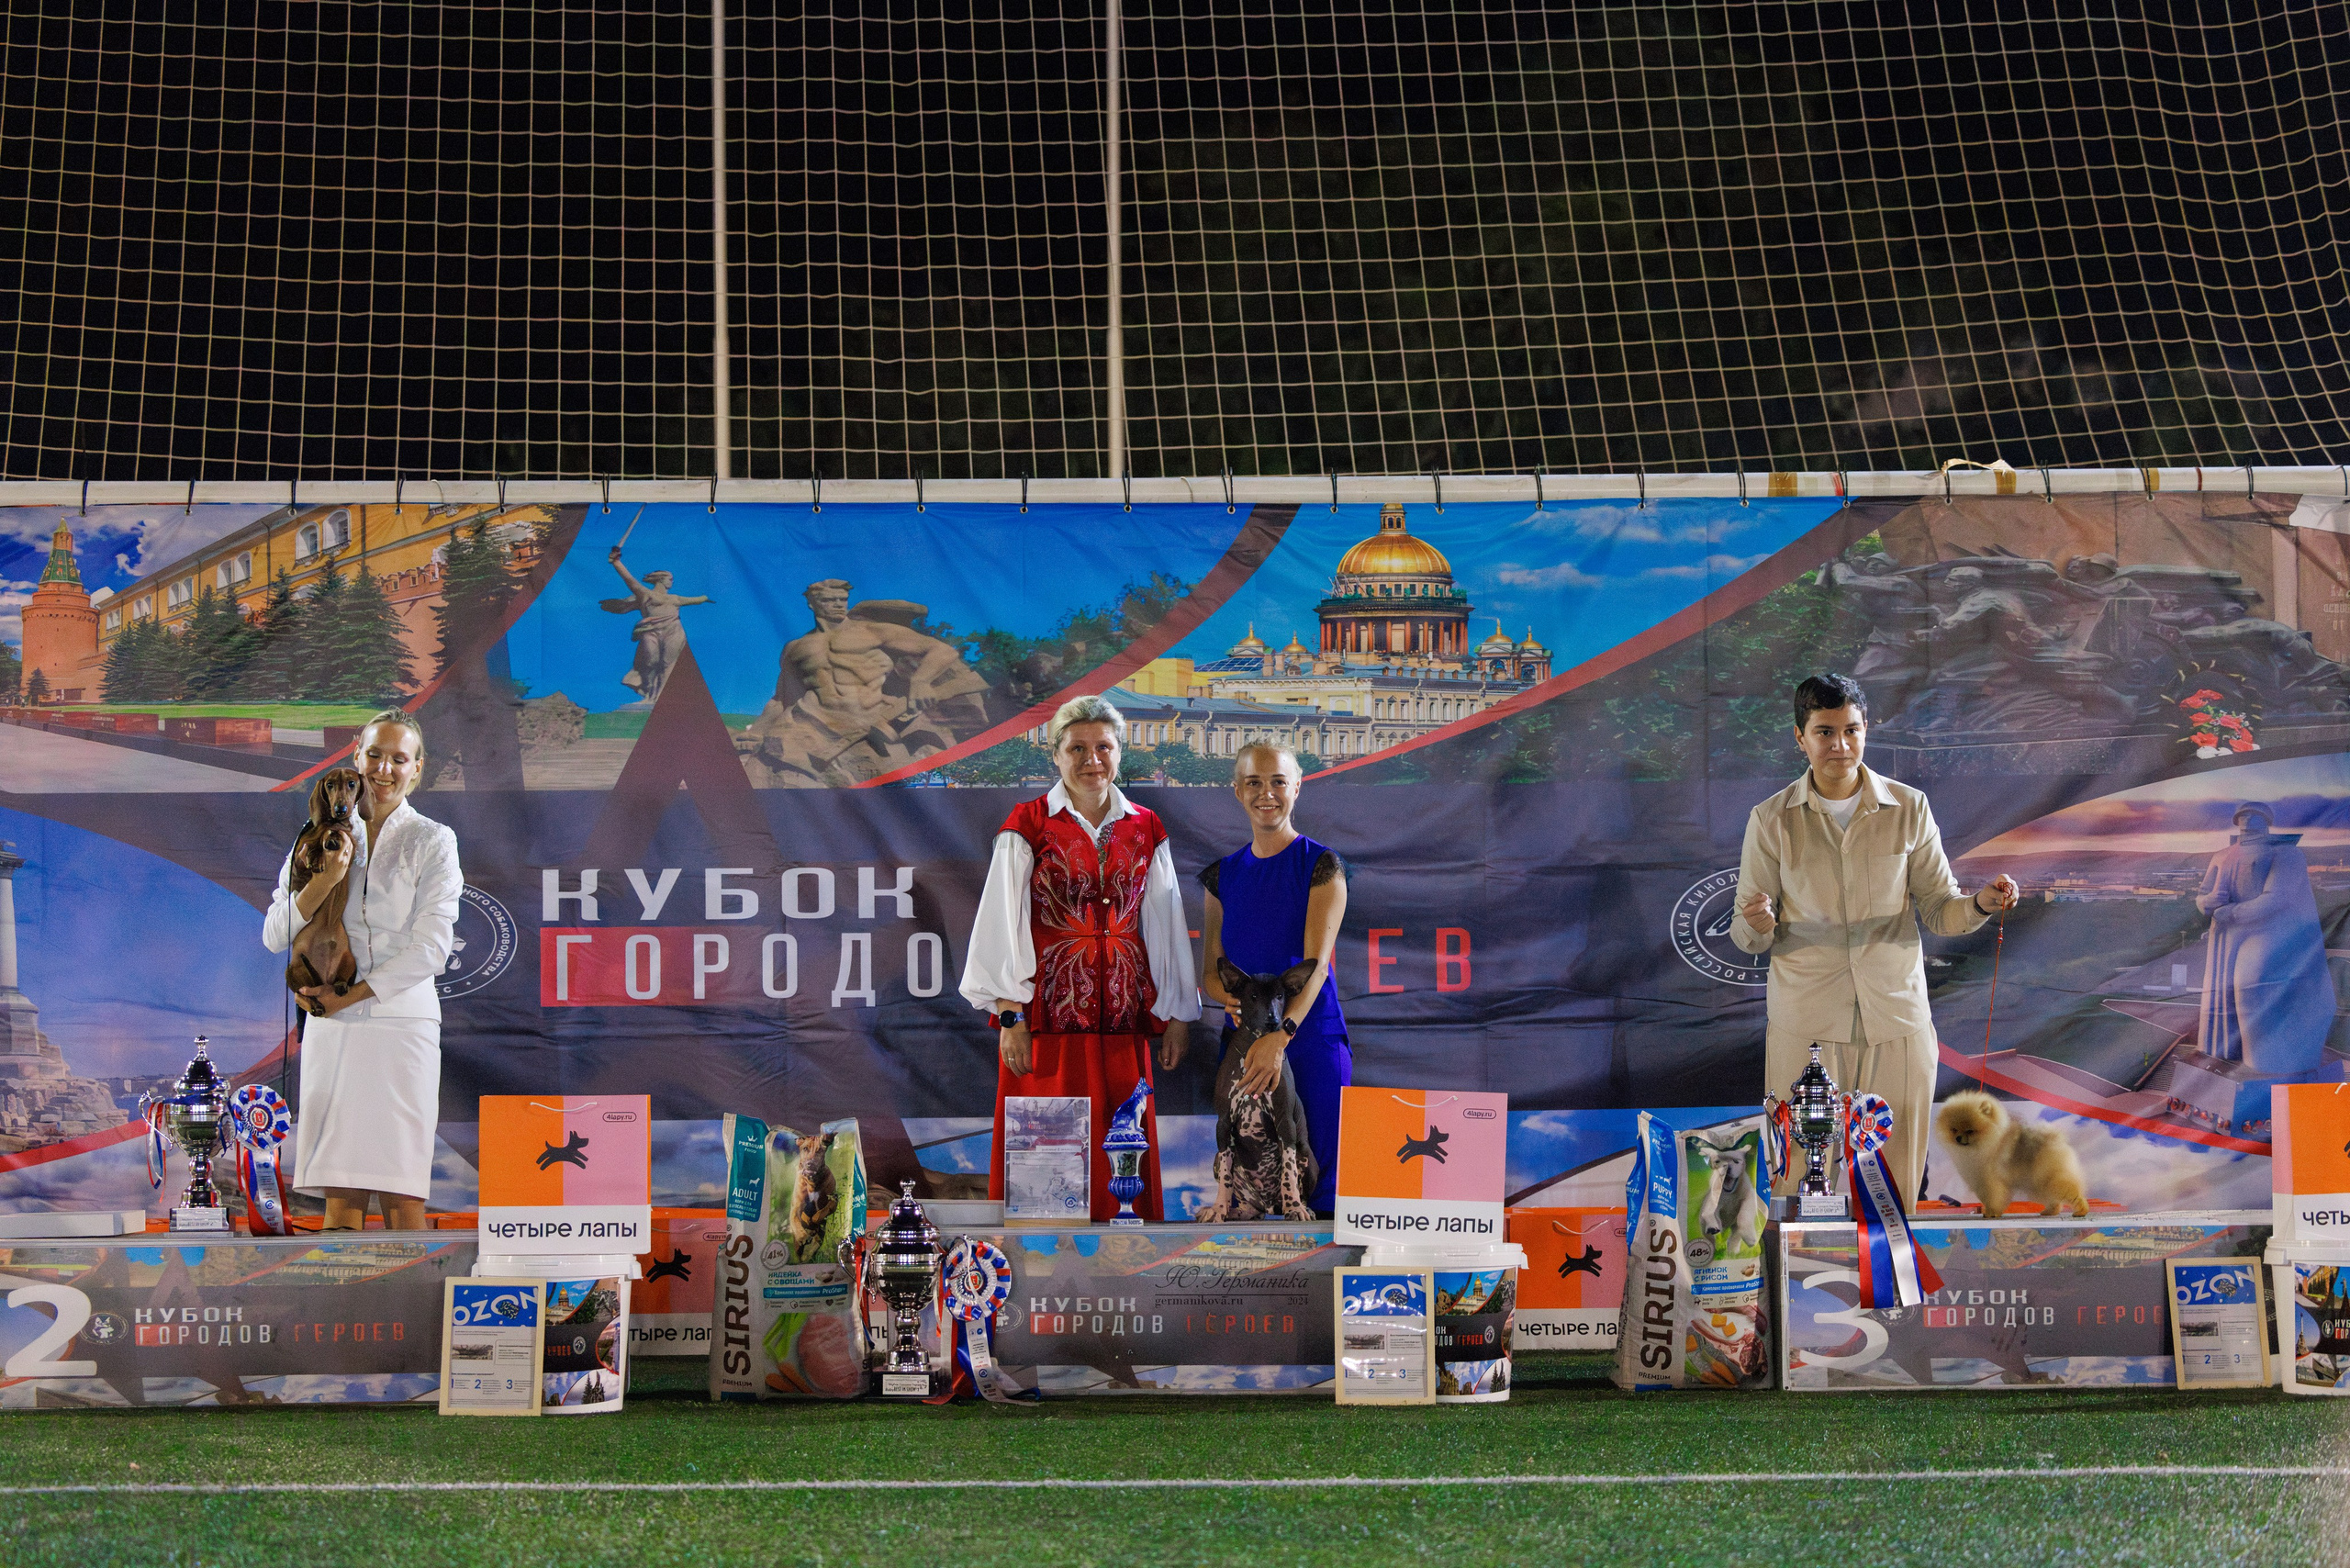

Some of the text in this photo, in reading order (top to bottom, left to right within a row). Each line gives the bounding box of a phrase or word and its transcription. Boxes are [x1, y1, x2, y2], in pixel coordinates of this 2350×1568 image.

[542, 867, 917, 922] КУБОК
[481, 905, 510, 976] СОБАКОВОДСТВА
[1677, 912, 1746, 980] РОССИЙСКАЯ
[556, 931, 943, 1008] ГОРОДО
[606, 1113, 632, 1122] 4lapy.ru
[1467, 1110, 1493, 1118] 4lapy.ru
[732, 1187, 758, 1201] ADULT
[1652, 1182, 1673, 1199] PUPPY
[1347, 1213, 1494, 1234] четыре лапы
[2302, 1210, 2350, 1226] четы
[488, 1221, 638, 1238] четыре лапы
[767, 1249, 784, 1260] 41%
[1689, 1248, 1709, 1258] 48%
[1694, 1266, 1728, 1275] ЯГНЕНОК
[774, 1277, 815, 1285] ОВОЩАМИ
[2177, 1265, 2255, 1305] OZON
[1342, 1275, 1427, 1316] OZON
[1639, 1228, 1677, 1371] SIRIUS
[1924, 1288, 2028, 1305] КУБОК
[452, 1285, 538, 1326] OZON
[722, 1233, 754, 1376] SIRIUS
[1030, 1296, 1137, 1313] КУБОК
[135, 1307, 243, 1324] КУБОК
[1799, 1270, 1889, 1368] 3
[1927, 1305, 2055, 1328] ГОРОДОВ
[2076, 1305, 2163, 1325] ГЕРОЕ
[5, 1283, 98, 1378] 2
[629, 1327, 678, 1341] тыре
[1034, 1314, 1164, 1337] ГОРОДОВ
[1518, 1321, 1617, 1337] четыре ла
[138, 1322, 405, 1347] ГОРОДОВ ГЕРОЕВ
[2204, 1354, 2212, 1365] 2
[2233, 1353, 2242, 1364] 3
[1368, 1368, 1376, 1379] 2
[1398, 1368, 1406, 1379] 3
[1638, 1372, 1671, 1381] PREMIUM
[474, 1378, 482, 1390] 2
[505, 1379, 514, 1391] 3
[722, 1378, 753, 1387] PREMIUM
